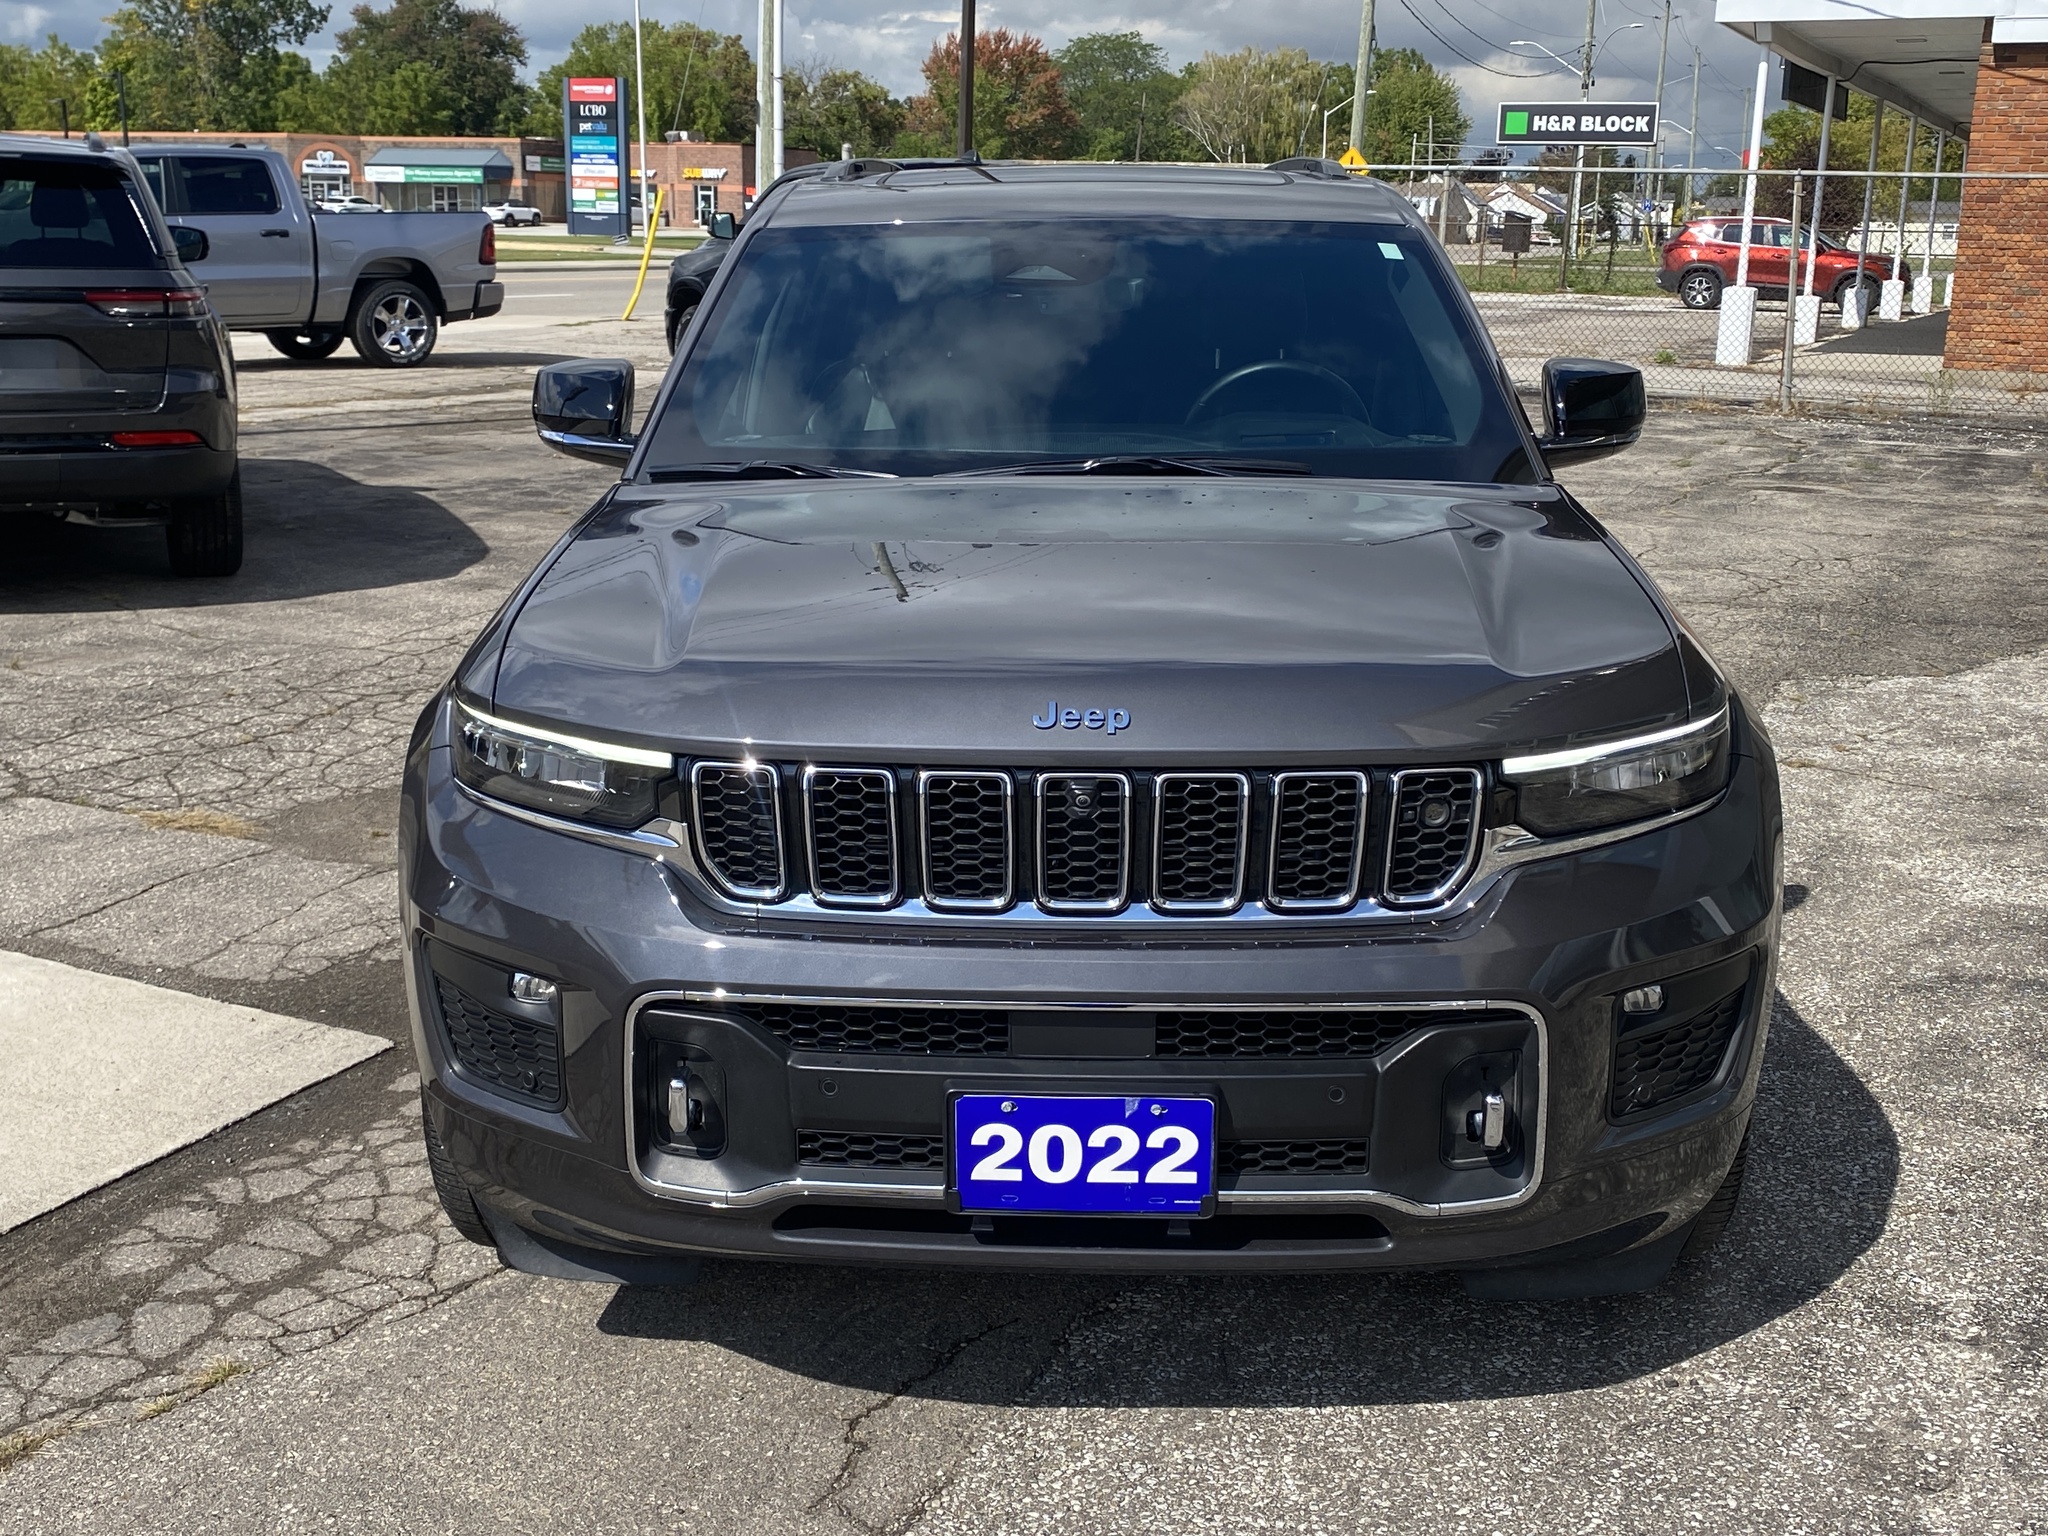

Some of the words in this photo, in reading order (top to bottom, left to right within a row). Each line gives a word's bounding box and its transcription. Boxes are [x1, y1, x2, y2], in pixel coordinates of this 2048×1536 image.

[579, 104, 607, 117] LCBO
[1532, 115, 1575, 132] H&R
[1580, 115, 1650, 133] BLOCK
[682, 167, 728, 179] SUBWAY
[1032, 700, 1131, 735] Jeep
[970, 1123, 1199, 1184] 2022
